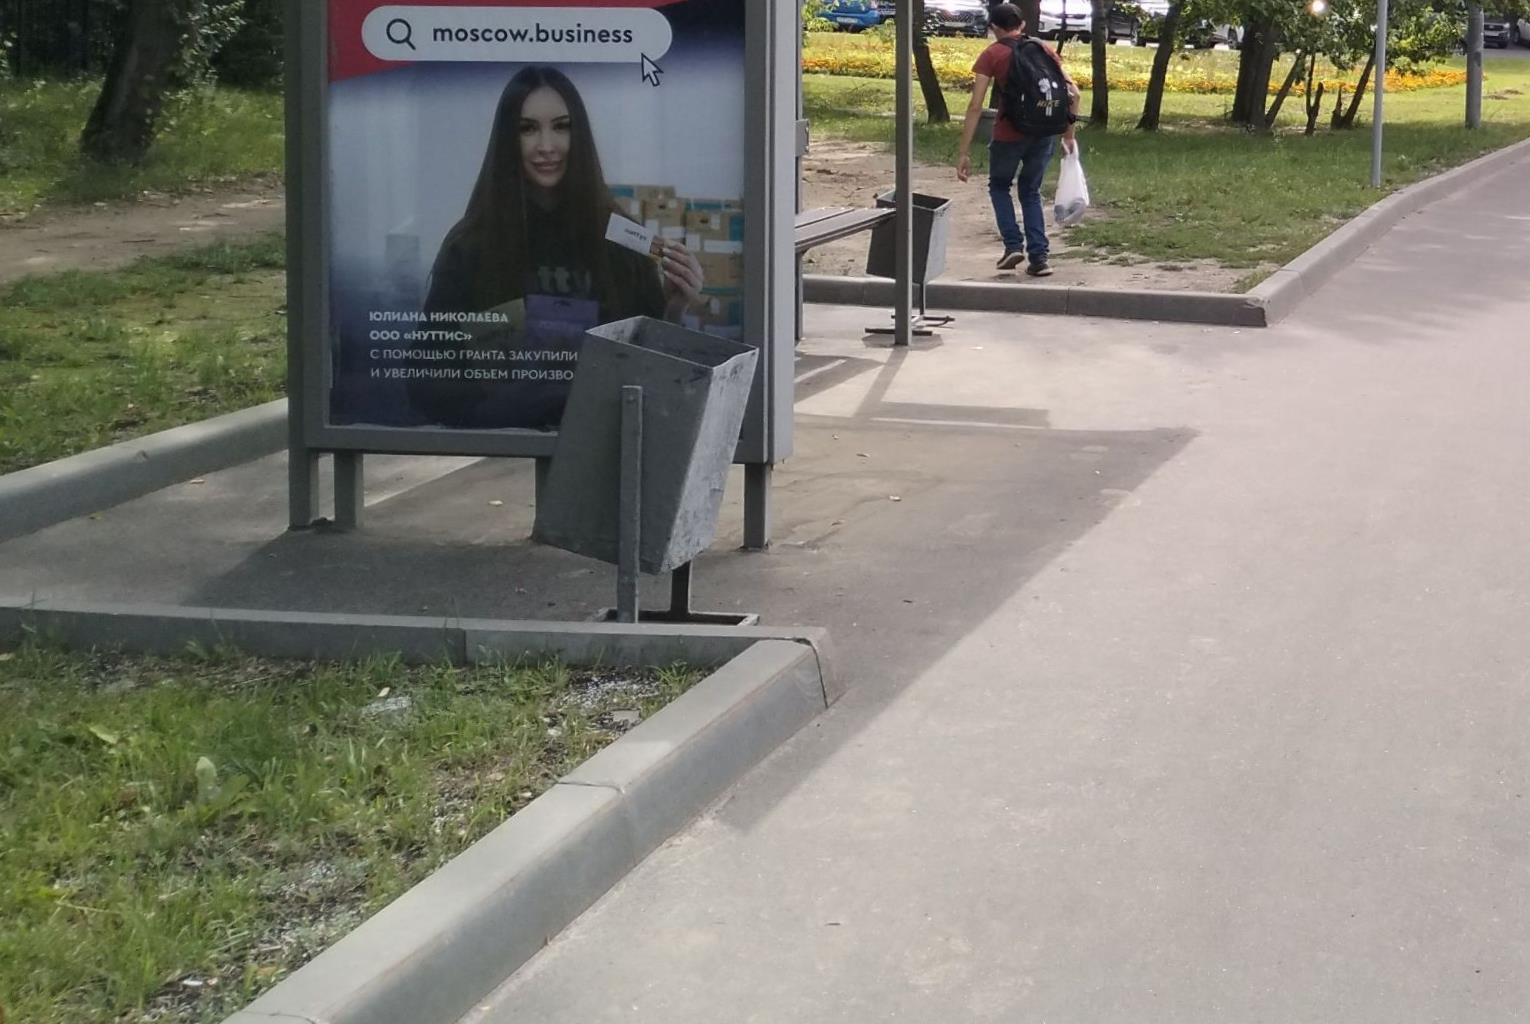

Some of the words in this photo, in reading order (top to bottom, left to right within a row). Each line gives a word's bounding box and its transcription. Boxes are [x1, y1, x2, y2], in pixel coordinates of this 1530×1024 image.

[432, 22, 633, 44] moscow.business
[369, 311, 428, 322] ЮЛИАНА
[430, 311, 509, 323] НИКОЛАЕВА
[369, 329, 401, 341] ООО
[403, 330, 473, 341] «НУТТИС»
[369, 348, 380, 359] С
[382, 348, 457, 361] ПОМОЩЬЮ
[459, 349, 506, 361] ГРАНТА
[509, 350, 578, 361] ЗАКУПИЛИ
[370, 367, 380, 378] И
[383, 367, 461, 379] УВЕЛИЧИЛИ
[463, 368, 509, 380] ОБЪЕМ
[511, 369, 575, 381] ПРОИЗВО
